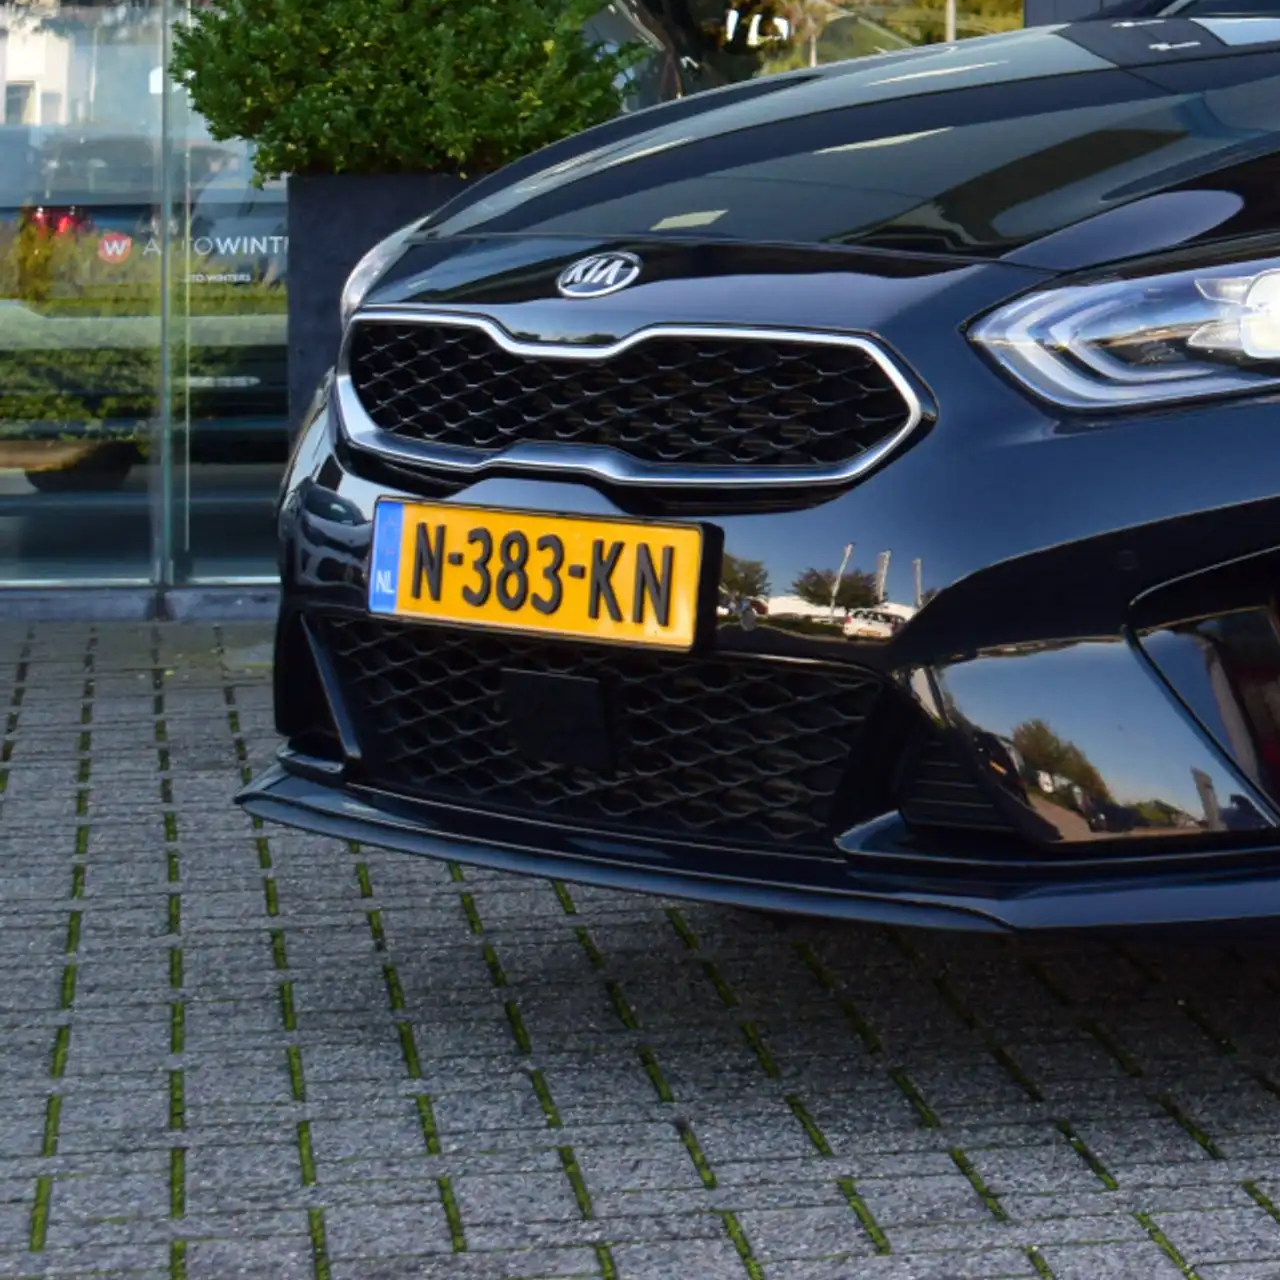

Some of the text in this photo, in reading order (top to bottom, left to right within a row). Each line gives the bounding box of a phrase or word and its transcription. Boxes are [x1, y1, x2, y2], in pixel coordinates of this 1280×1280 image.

[562, 256, 630, 288] KIA
[375, 570, 395, 595] NL
[410, 522, 675, 627] N-383-KN
